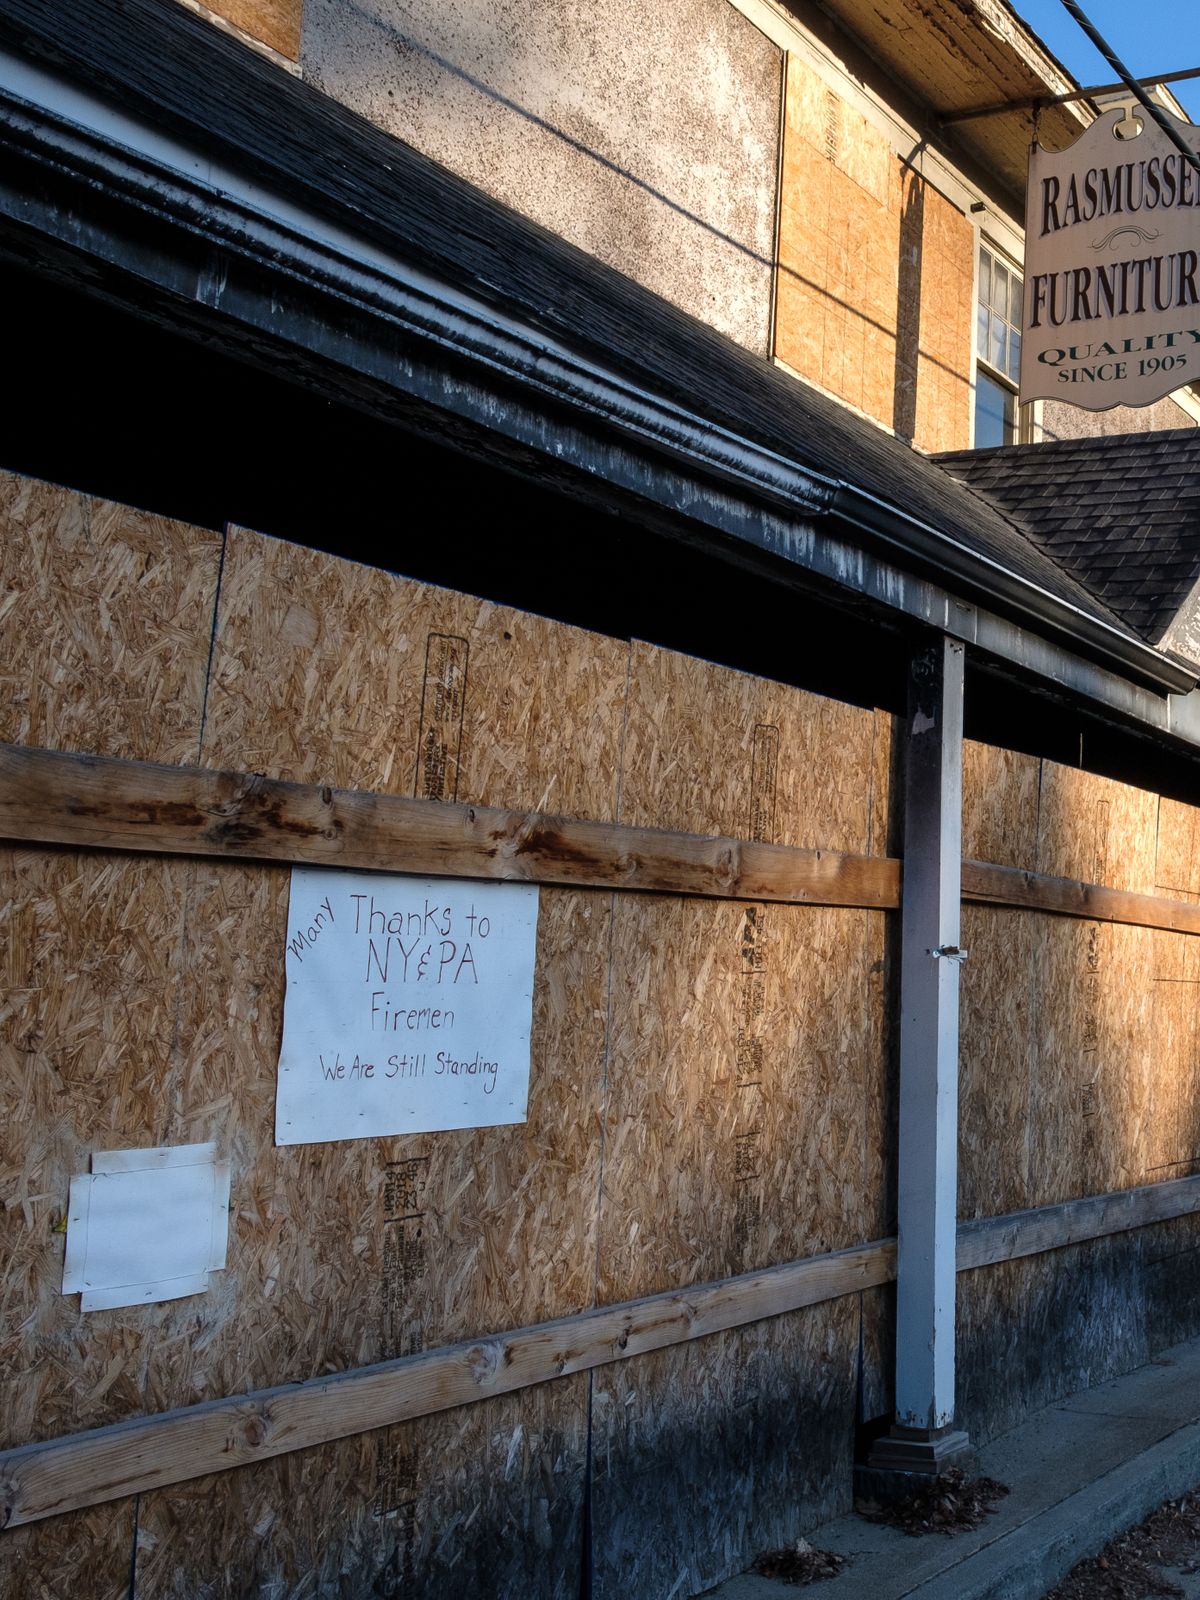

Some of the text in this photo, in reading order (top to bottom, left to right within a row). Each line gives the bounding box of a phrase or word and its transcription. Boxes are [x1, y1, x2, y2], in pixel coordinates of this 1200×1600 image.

[1057, 353, 1188, 384] SINCE 1905
[287, 896, 335, 963] Many
[350, 894, 491, 938] Thanks to
[371, 991, 456, 1032] Firemen
[319, 1051, 499, 1095] We Are Still Standing
[395, 1171, 407, 1210] 2018
[405, 1162, 418, 1211] 23:46
